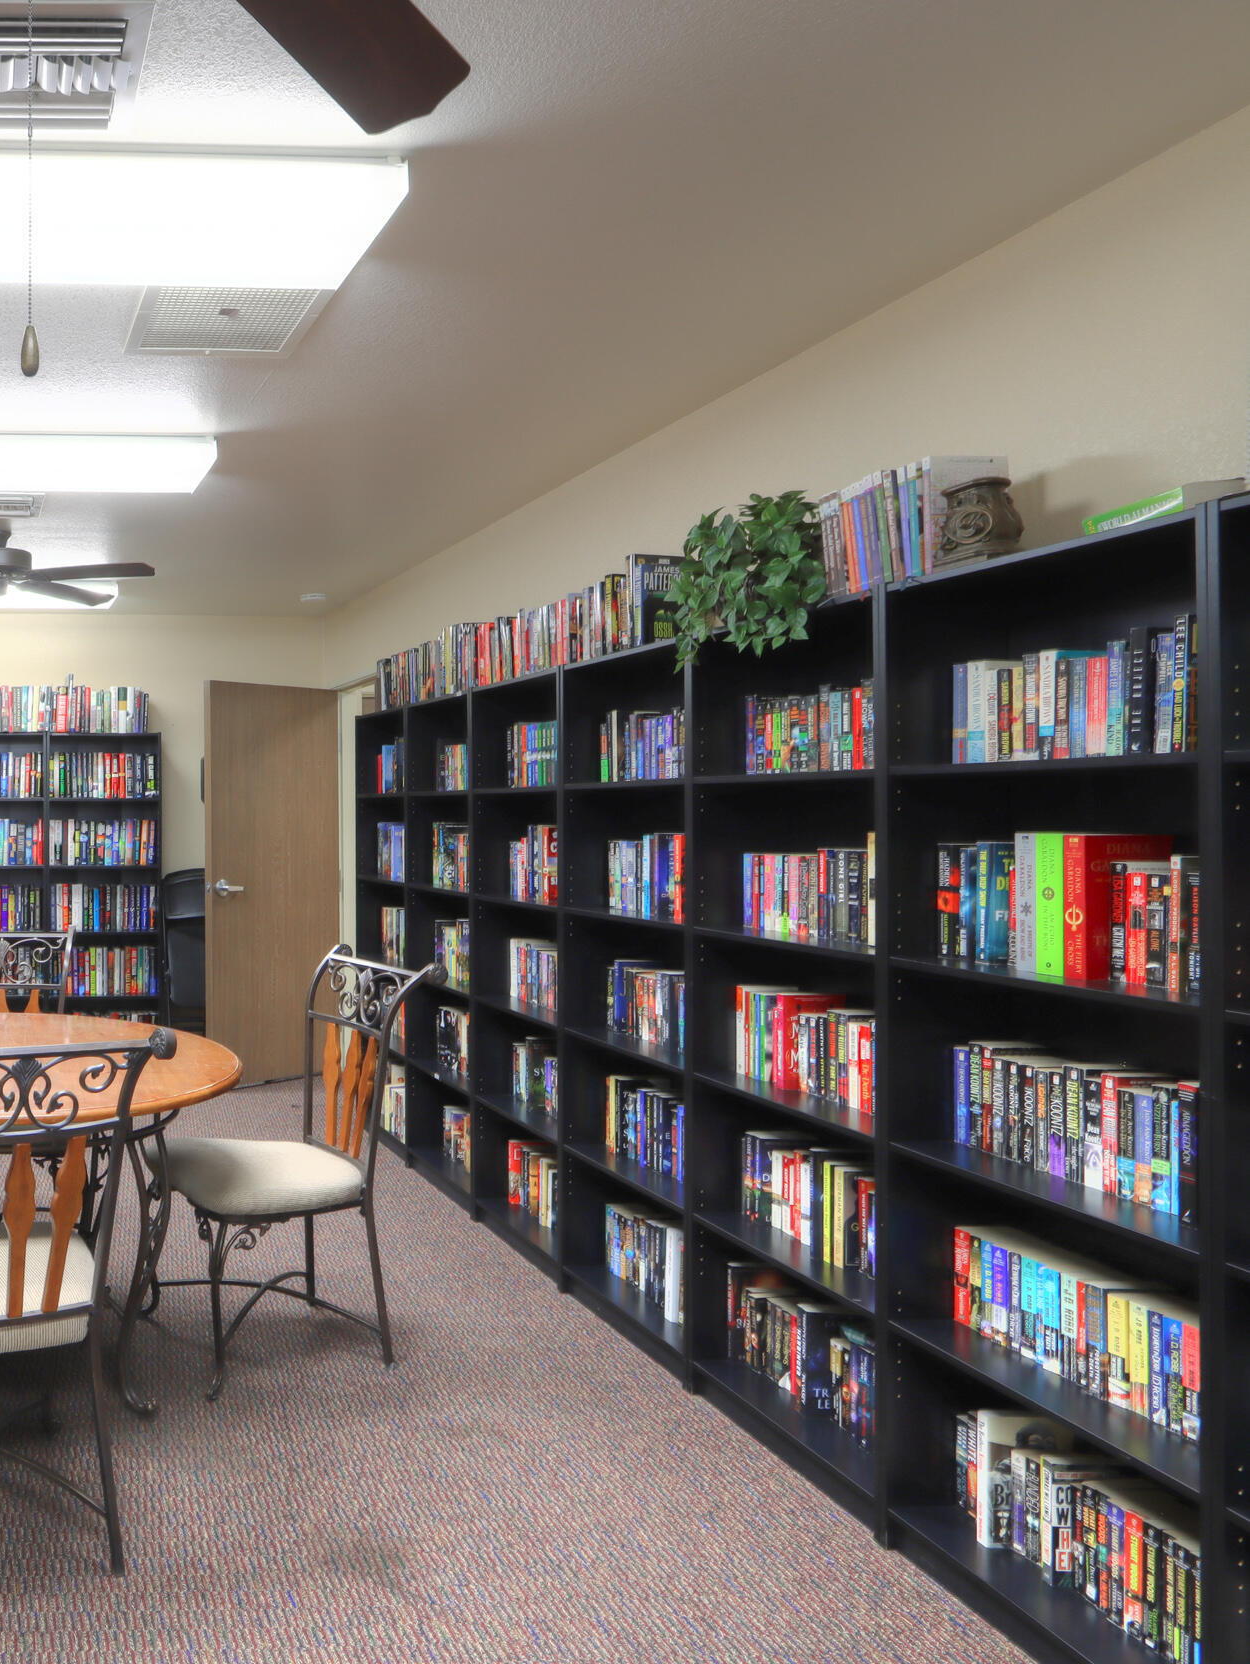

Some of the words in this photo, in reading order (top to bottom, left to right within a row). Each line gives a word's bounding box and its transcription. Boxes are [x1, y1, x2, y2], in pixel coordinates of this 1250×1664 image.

[1102, 513, 1130, 531] WORLD
[643, 573, 693, 591] PATTER
[1176, 619, 1184, 639] LEE
[1175, 644, 1184, 678] CHILD
[1001, 681, 1009, 705] SANDRA
[1001, 732, 1010, 754] BROWN
[1067, 860, 1075, 902] GABALDON
[1113, 875, 1121, 890] LISA
[1112, 892, 1123, 923] GARDNER
[1113, 927, 1124, 947] CATCH
[1151, 930, 1159, 951] ALONE
[1113, 948, 1124, 958] ME
[970, 1055, 979, 1072] DEAN
[862, 1078, 870, 1100] Death
[970, 1075, 980, 1103] KOONTZ
[993, 1084, 1003, 1116] KOONTZ
[1066, 1080, 1078, 1103] DEAN
[1024, 1091, 1033, 1126] KOONTZ
[1050, 1099, 1063, 1136] KOONTZ
[1066, 1105, 1078, 1139] KOONTZ
[1182, 1110, 1191, 1165] ARMAGEDDON
[968, 1429, 976, 1463] WHITE
[1025, 1472, 1039, 1513] BLINDED
[1097, 1514, 1106, 1544] WOODS
[1130, 1535, 1138, 1561] STUART
[1130, 1563, 1138, 1591] WOODS
[1166, 1556, 1174, 1583] STUART
[1177, 1567, 1185, 1596] STUART
[1178, 1597, 1186, 1626] WOODS
